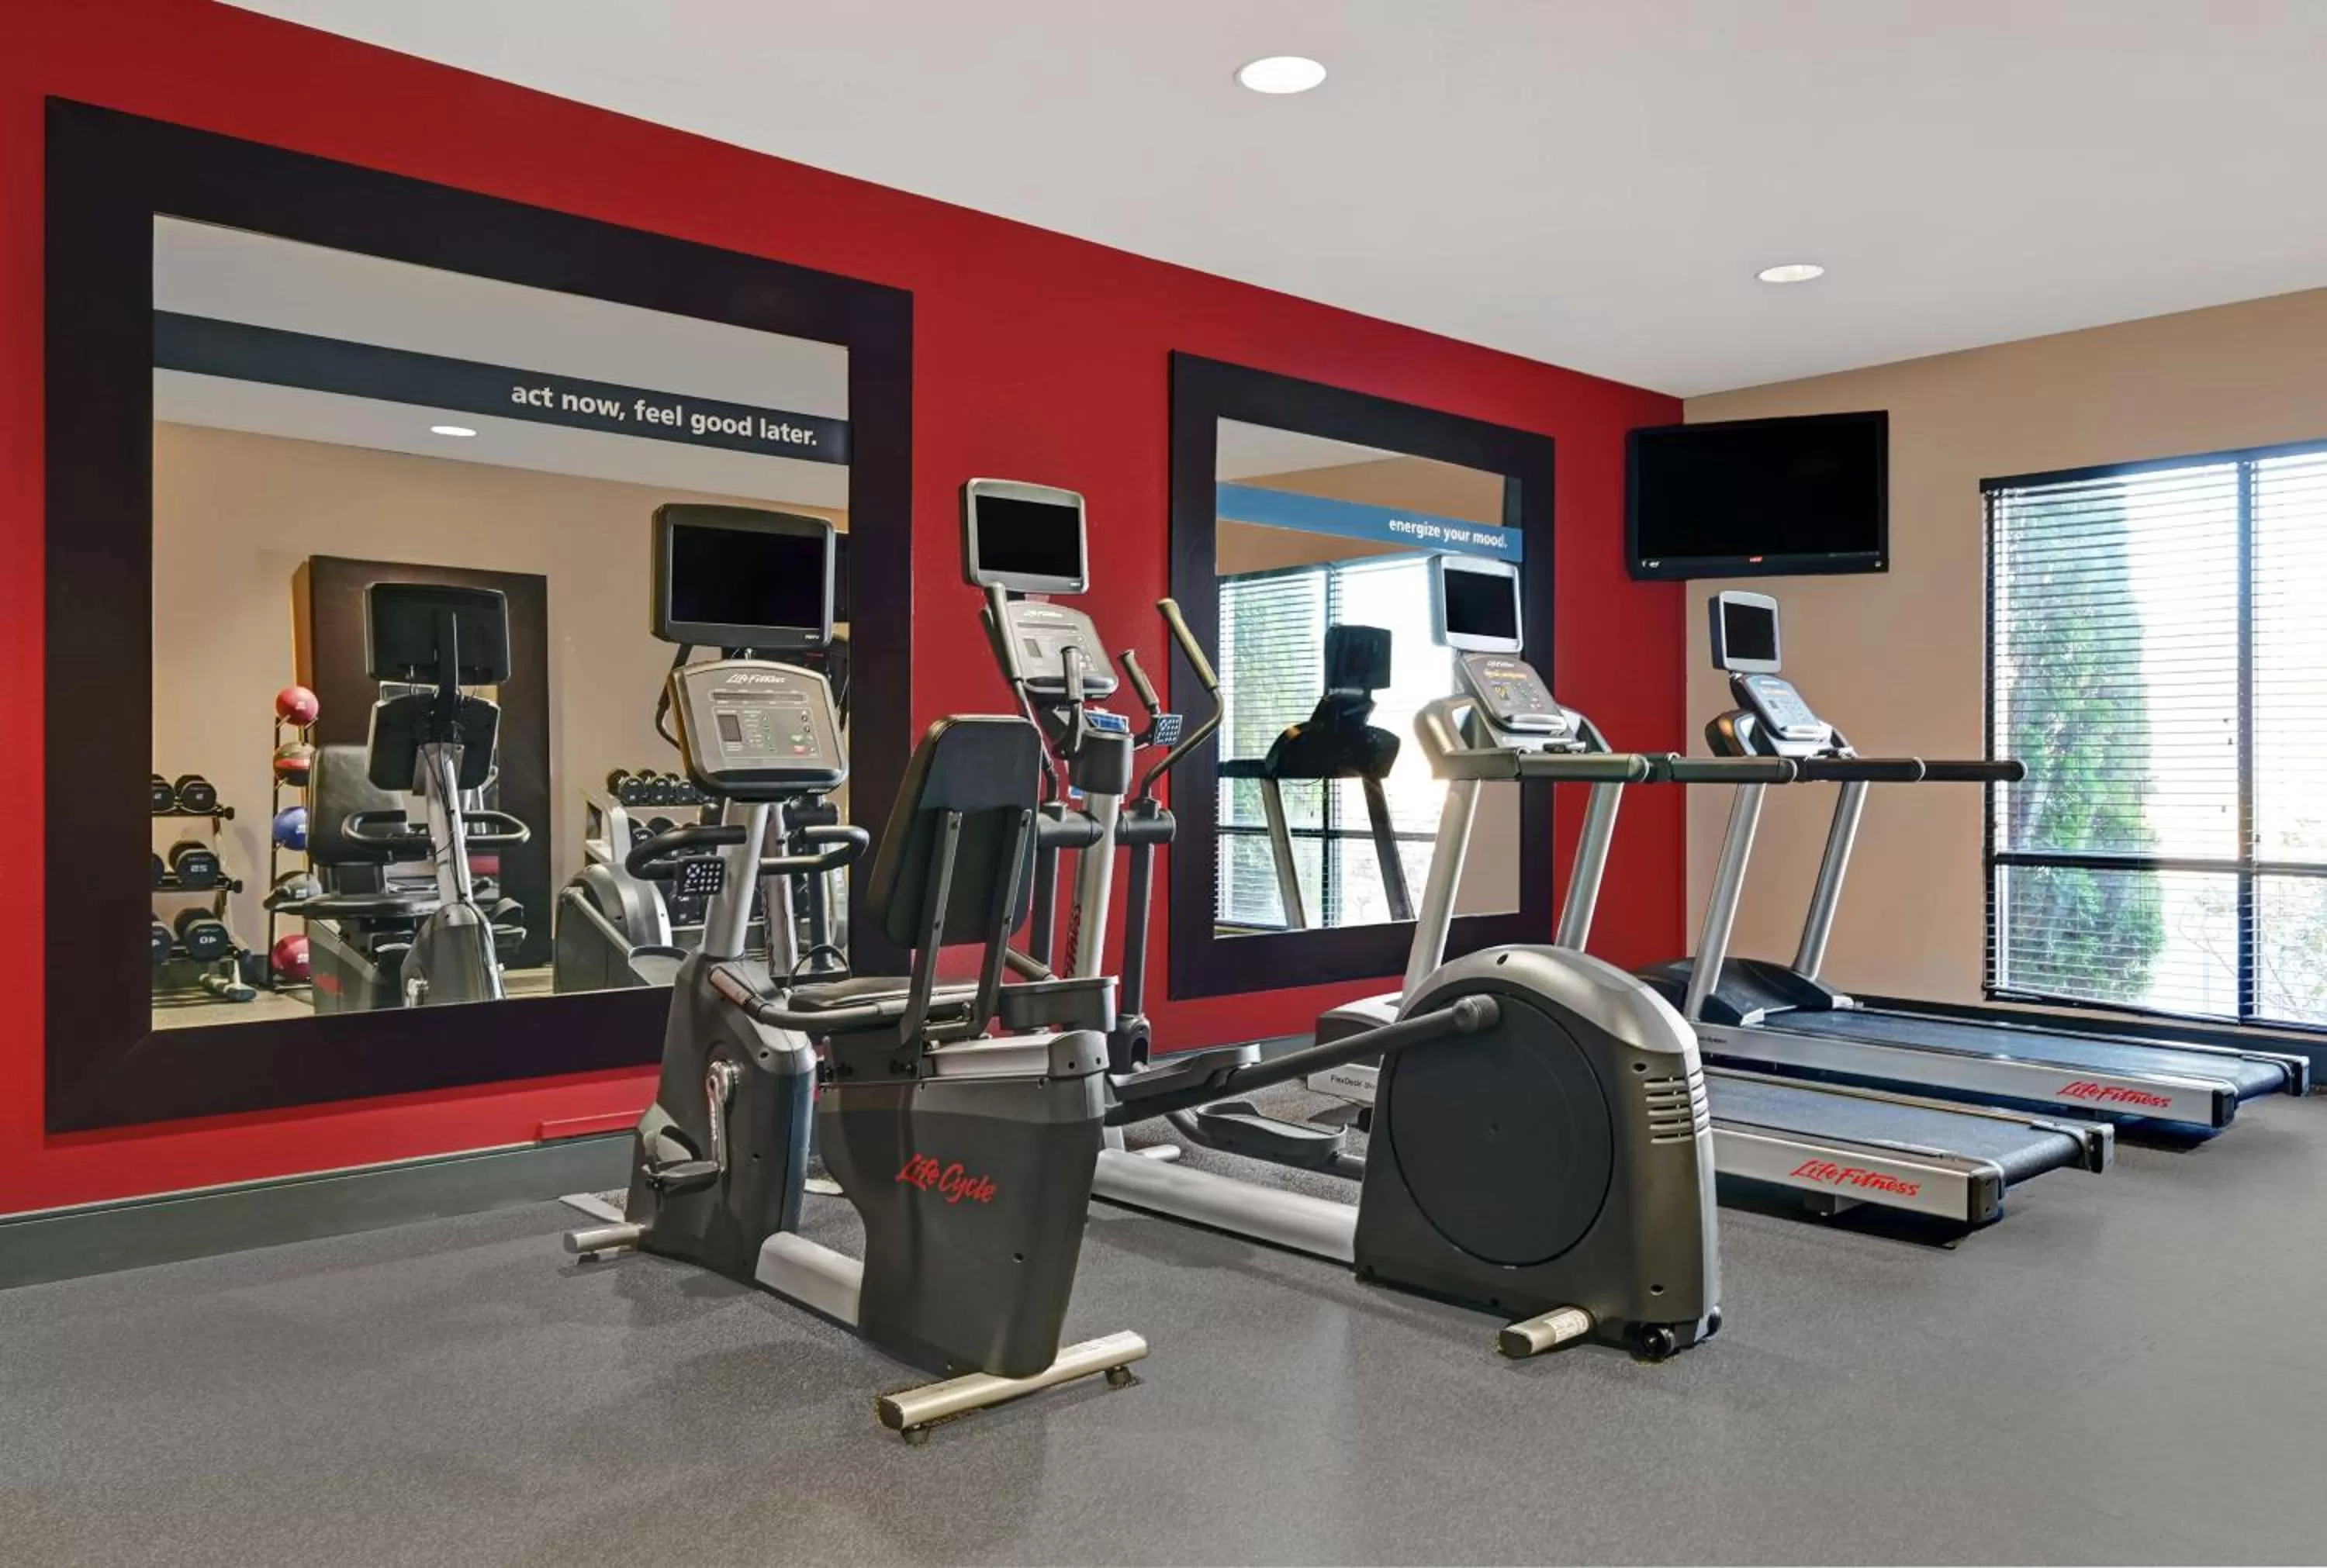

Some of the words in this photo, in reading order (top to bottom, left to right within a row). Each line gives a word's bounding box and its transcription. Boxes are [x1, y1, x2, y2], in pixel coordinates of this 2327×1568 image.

[511, 386, 553, 408] act
[562, 393, 625, 421] now,
[634, 399, 683, 427] feel
[690, 413, 752, 437] good
[759, 418, 817, 446] later.
[1388, 519, 1441, 539] energize
[1444, 526, 1471, 543] your
[1473, 532, 1508, 549] mood.
